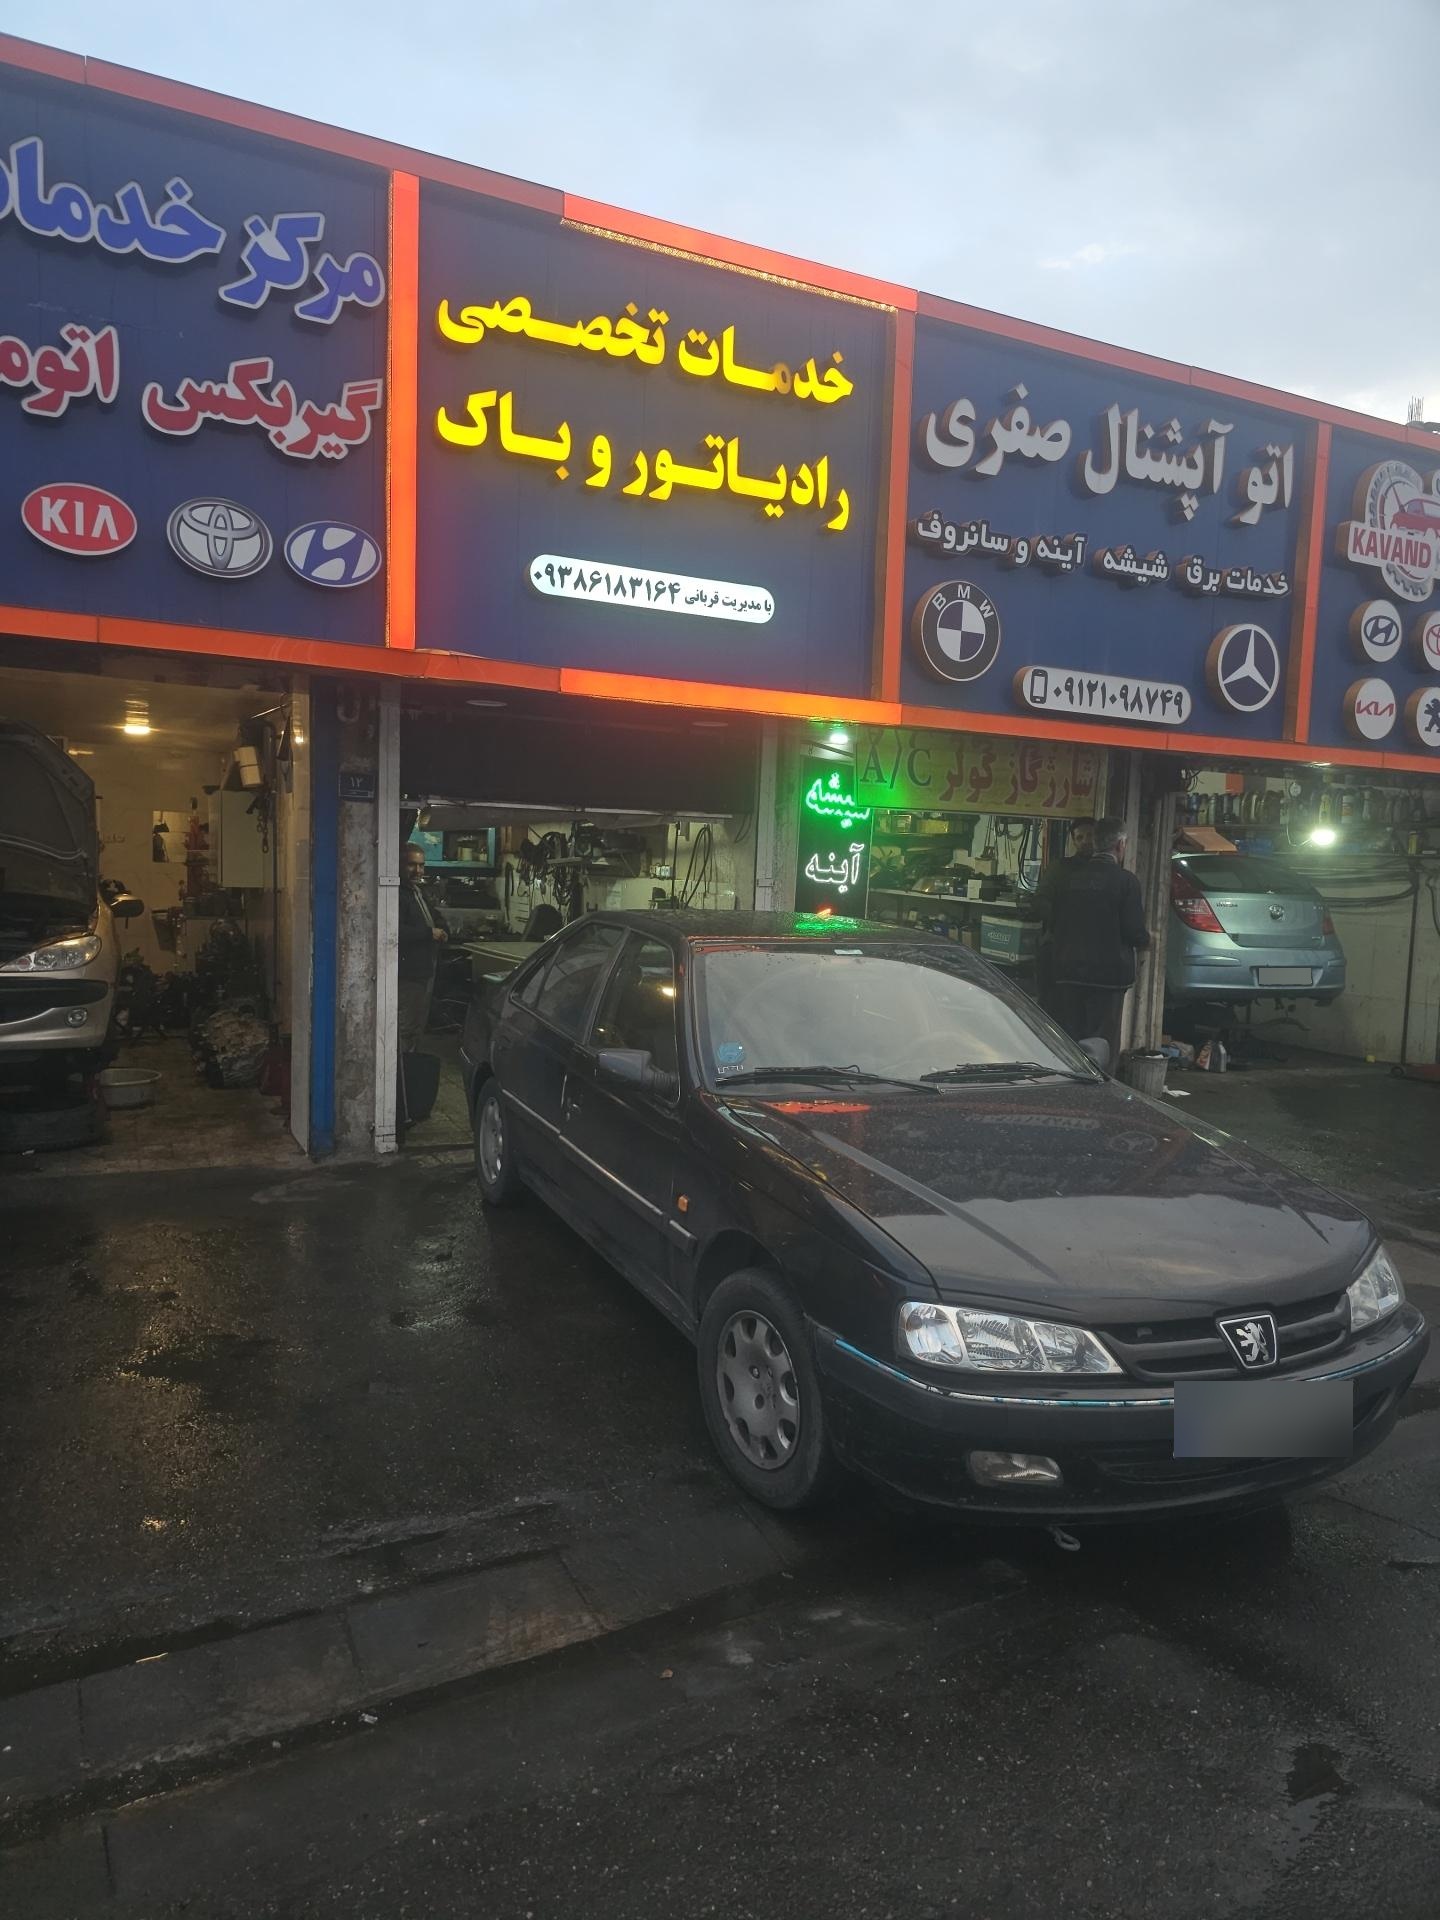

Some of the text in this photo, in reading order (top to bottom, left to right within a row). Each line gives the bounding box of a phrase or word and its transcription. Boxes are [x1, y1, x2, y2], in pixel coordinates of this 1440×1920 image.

[0, 137, 386, 325] مرکز خدما
[438, 297, 854, 403] خدمات تخصصی
[0, 323, 383, 460] گیربکس اتوم
[437, 390, 850, 531] رادیاتور و باک
[926, 383, 1294, 525] اتو آپشنال صفری
[40, 496, 119, 540] KIA
[917, 513, 1290, 596] خدمات برق شیشه آینه و سانروف
[1351, 526, 1432, 569] KAVAND
[533, 562, 773, 615] با مدیریت قربانی ۰۹۳۸۶۱۸۳۱۶۴
[932, 584, 994, 619] BMW
[1053, 676, 1184, 718] ۰۹۱۲۱۰۹۸۷۴۹
[860, 748, 932, 790] A/C
[805, 843, 865, 894] آینه
